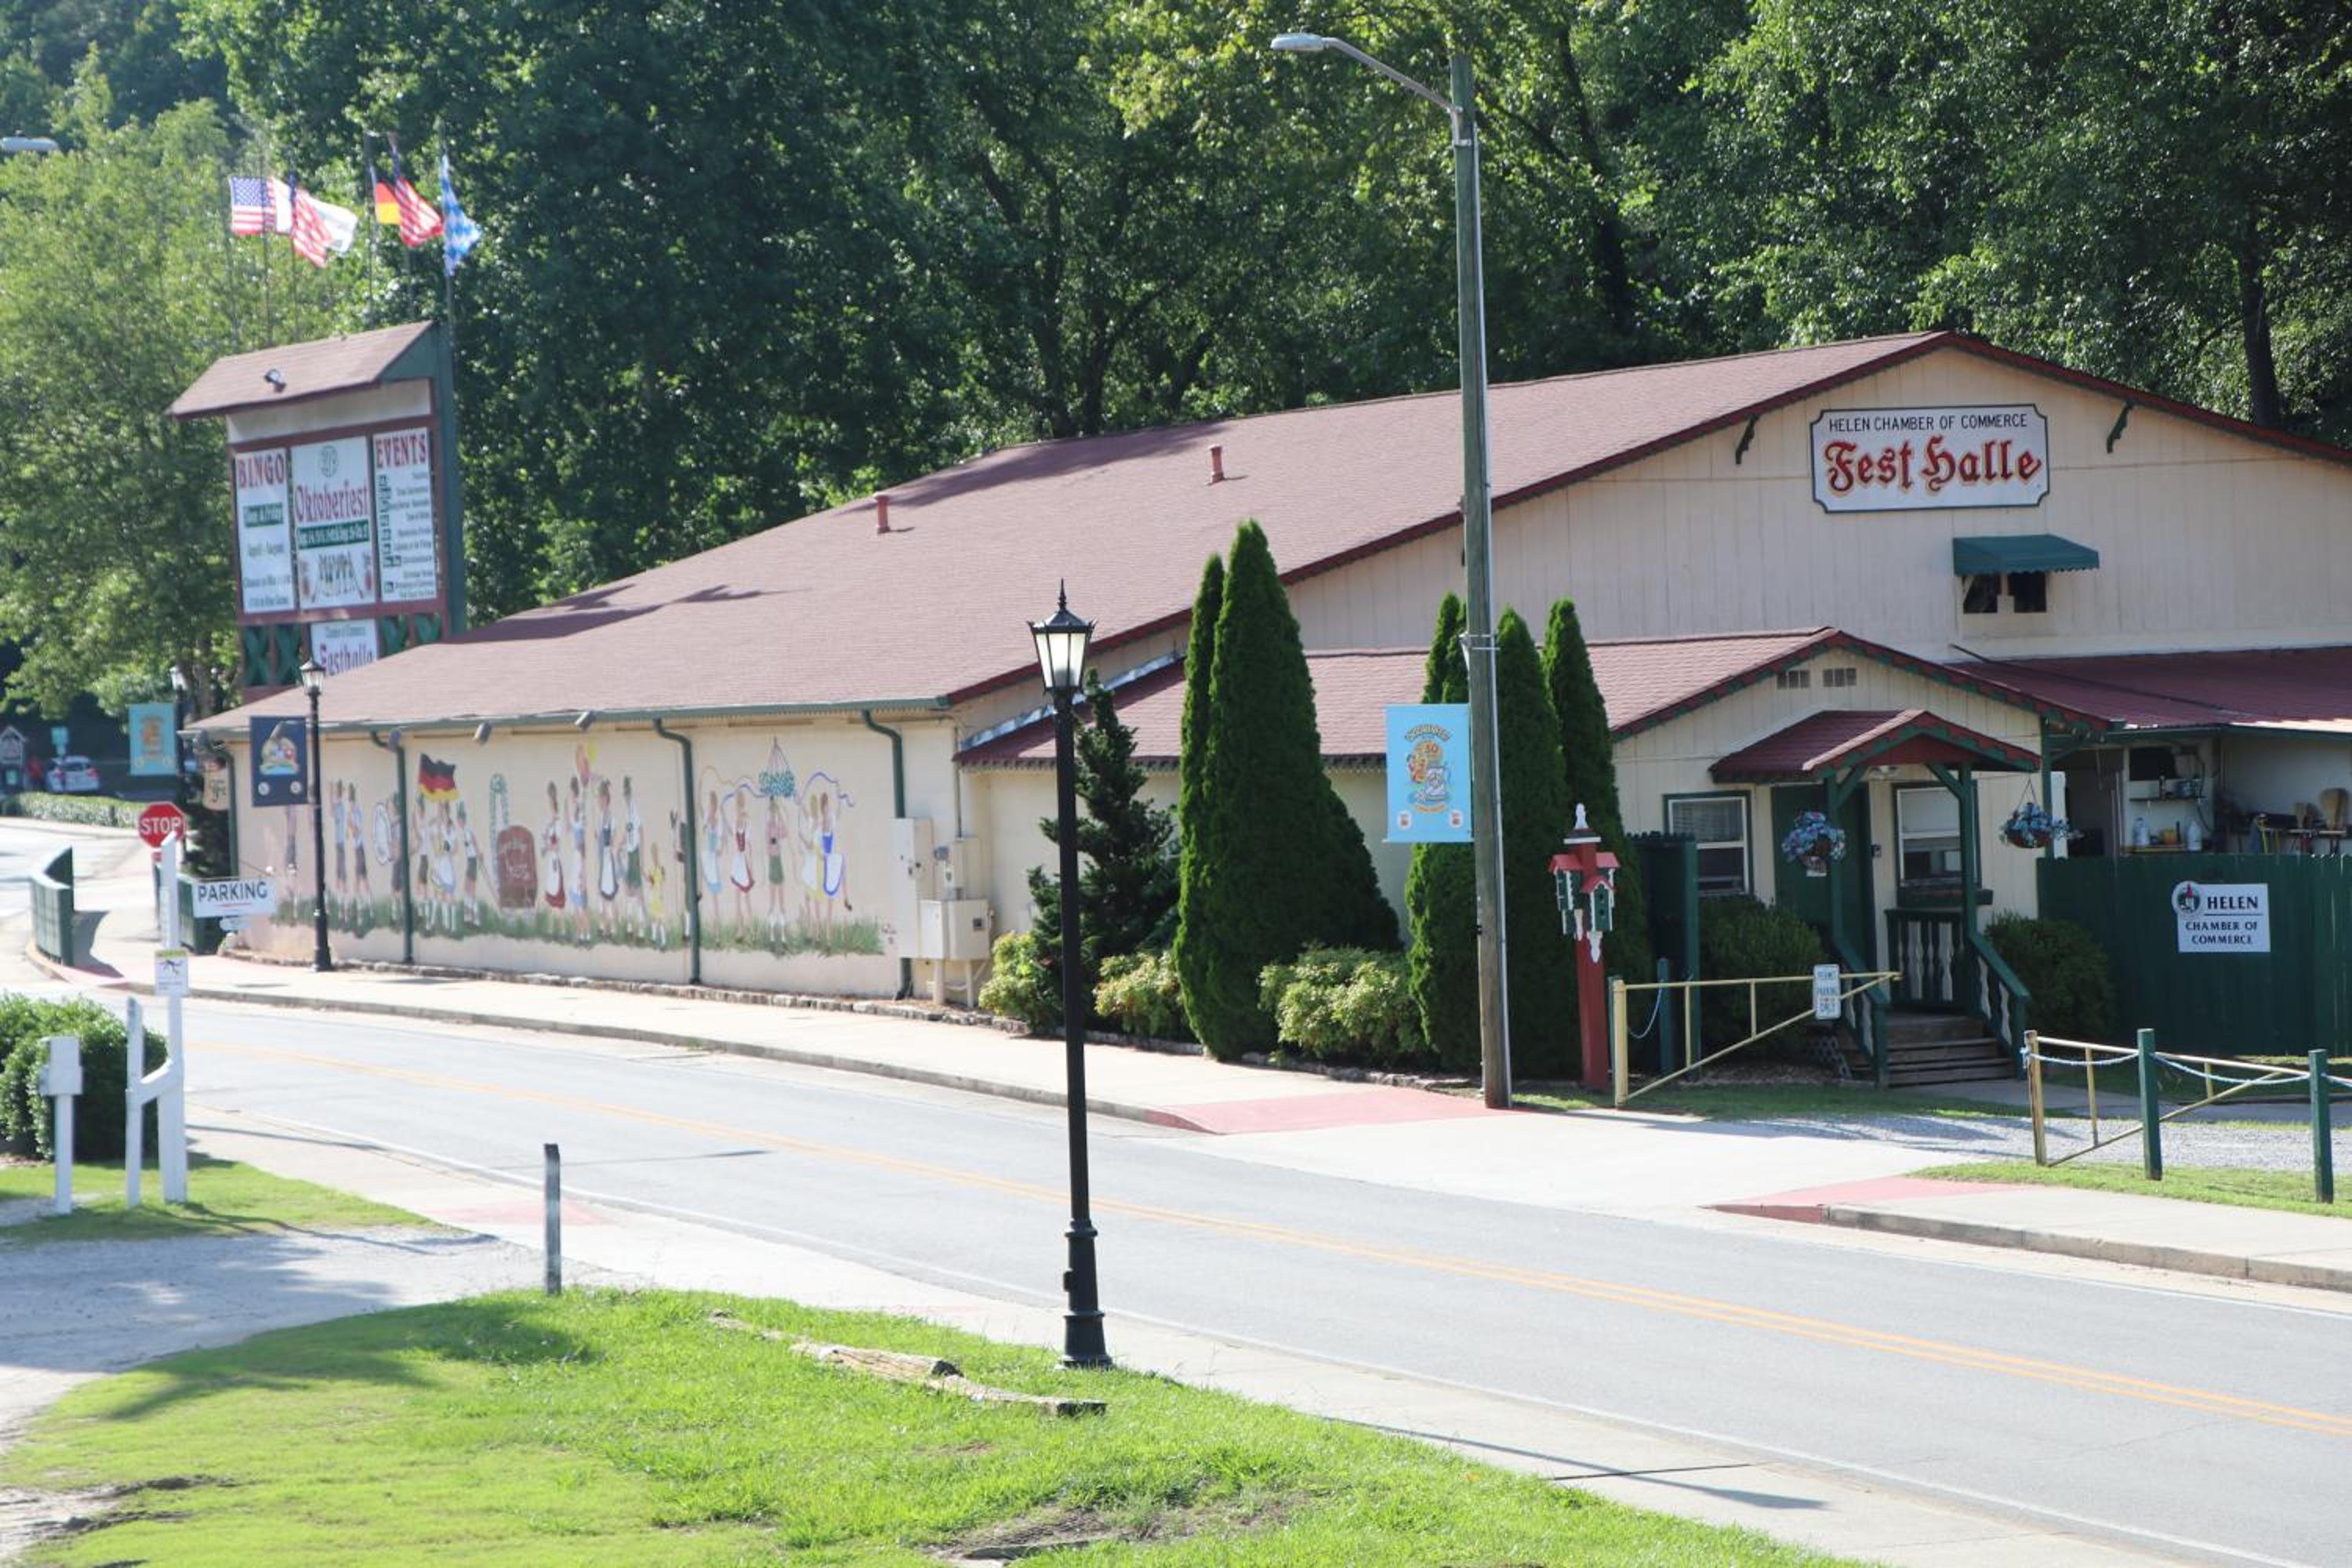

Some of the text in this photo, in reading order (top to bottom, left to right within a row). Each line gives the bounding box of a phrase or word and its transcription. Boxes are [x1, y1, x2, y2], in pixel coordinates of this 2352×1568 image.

[1829, 413, 2028, 432] HELEN CHAMBER OF COMMERCE
[376, 434, 426, 468] EVENTS
[238, 452, 285, 488] BINGO
[1824, 436, 1915, 494] Fest
[295, 480, 368, 521] Oktoberfest
[140, 816, 182, 835] STOP
[198, 882, 268, 902] PARKING
[2207, 896, 2259, 910] HELEN
[2185, 921, 2258, 931] CHAMBER OF
[2191, 935, 2252, 946] COMMERCE
